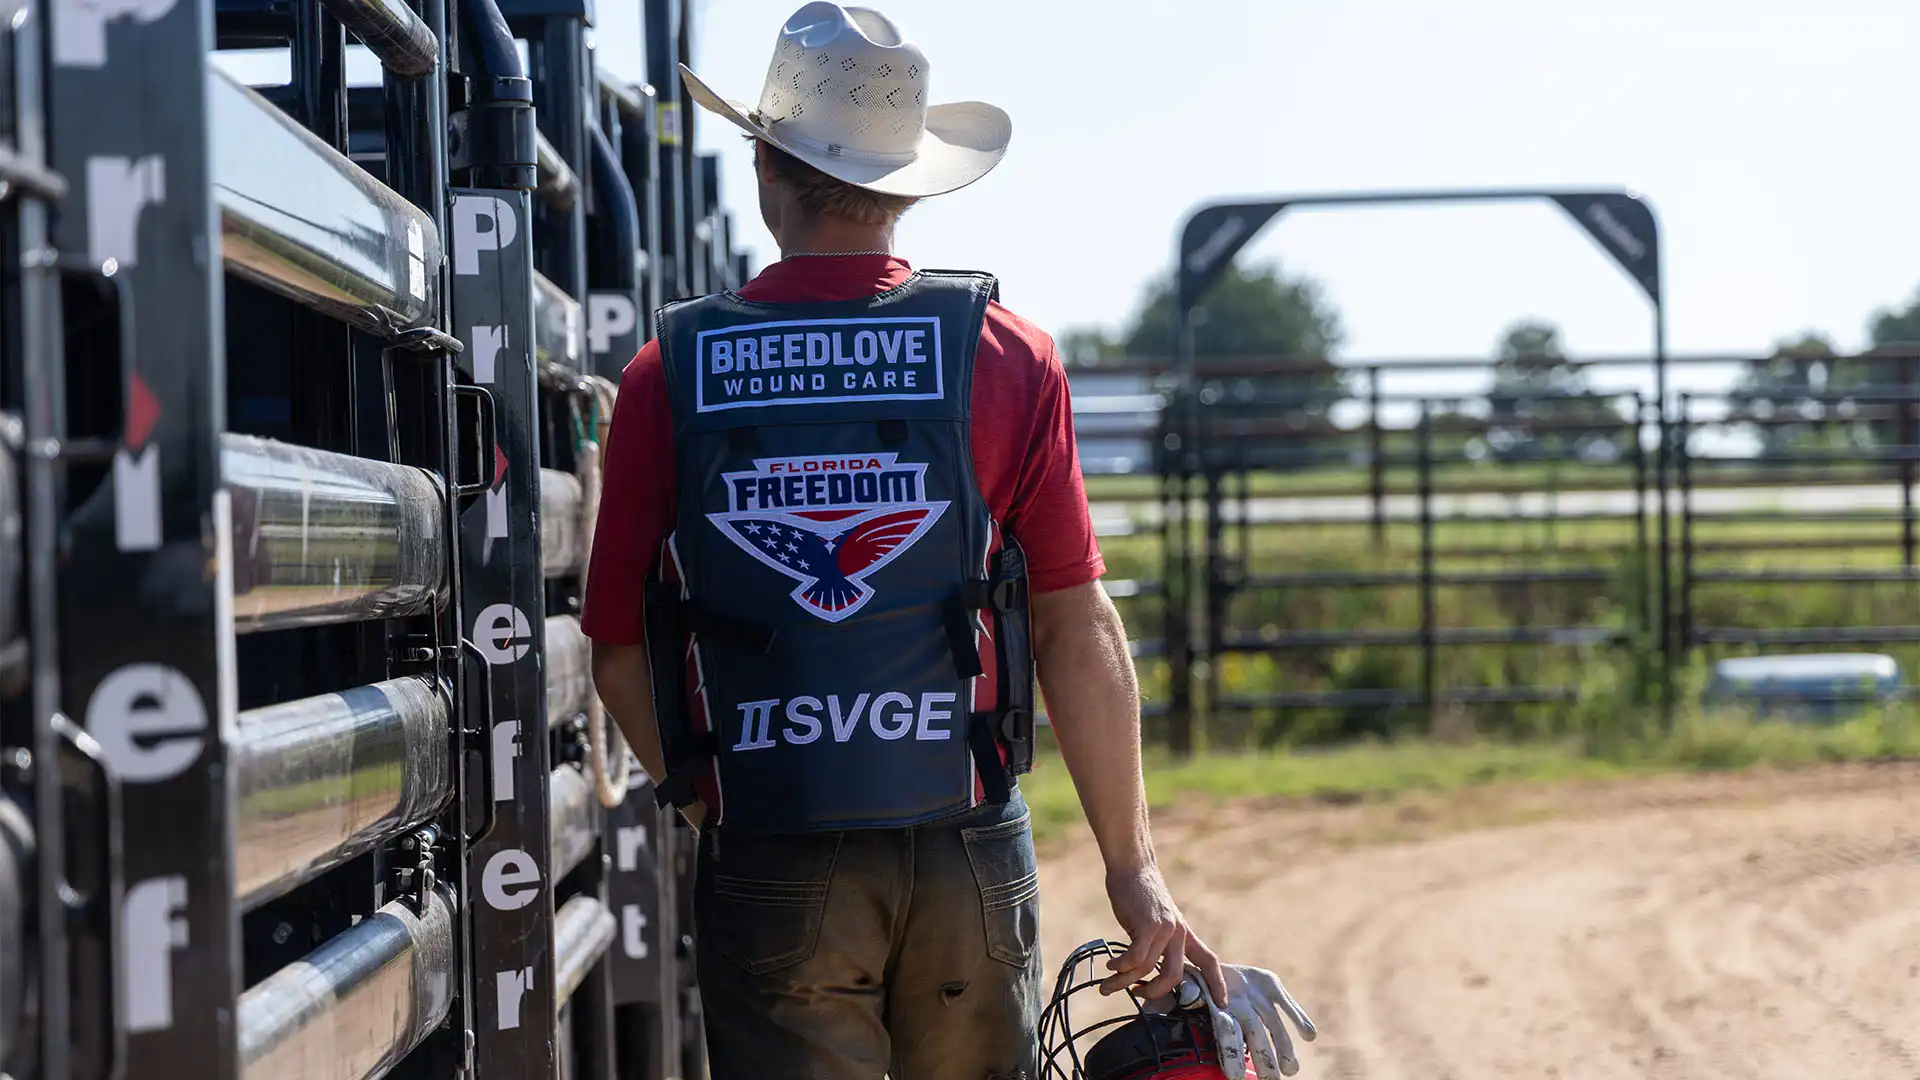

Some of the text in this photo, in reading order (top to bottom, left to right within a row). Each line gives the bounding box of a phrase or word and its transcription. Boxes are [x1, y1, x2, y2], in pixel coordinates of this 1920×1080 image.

[711, 329, 928, 375] BREEDLOVE
[724, 370, 917, 396] WOUND CARE
[769, 457, 883, 474] FLORIDA
[734, 470, 918, 511] FREEDOM
